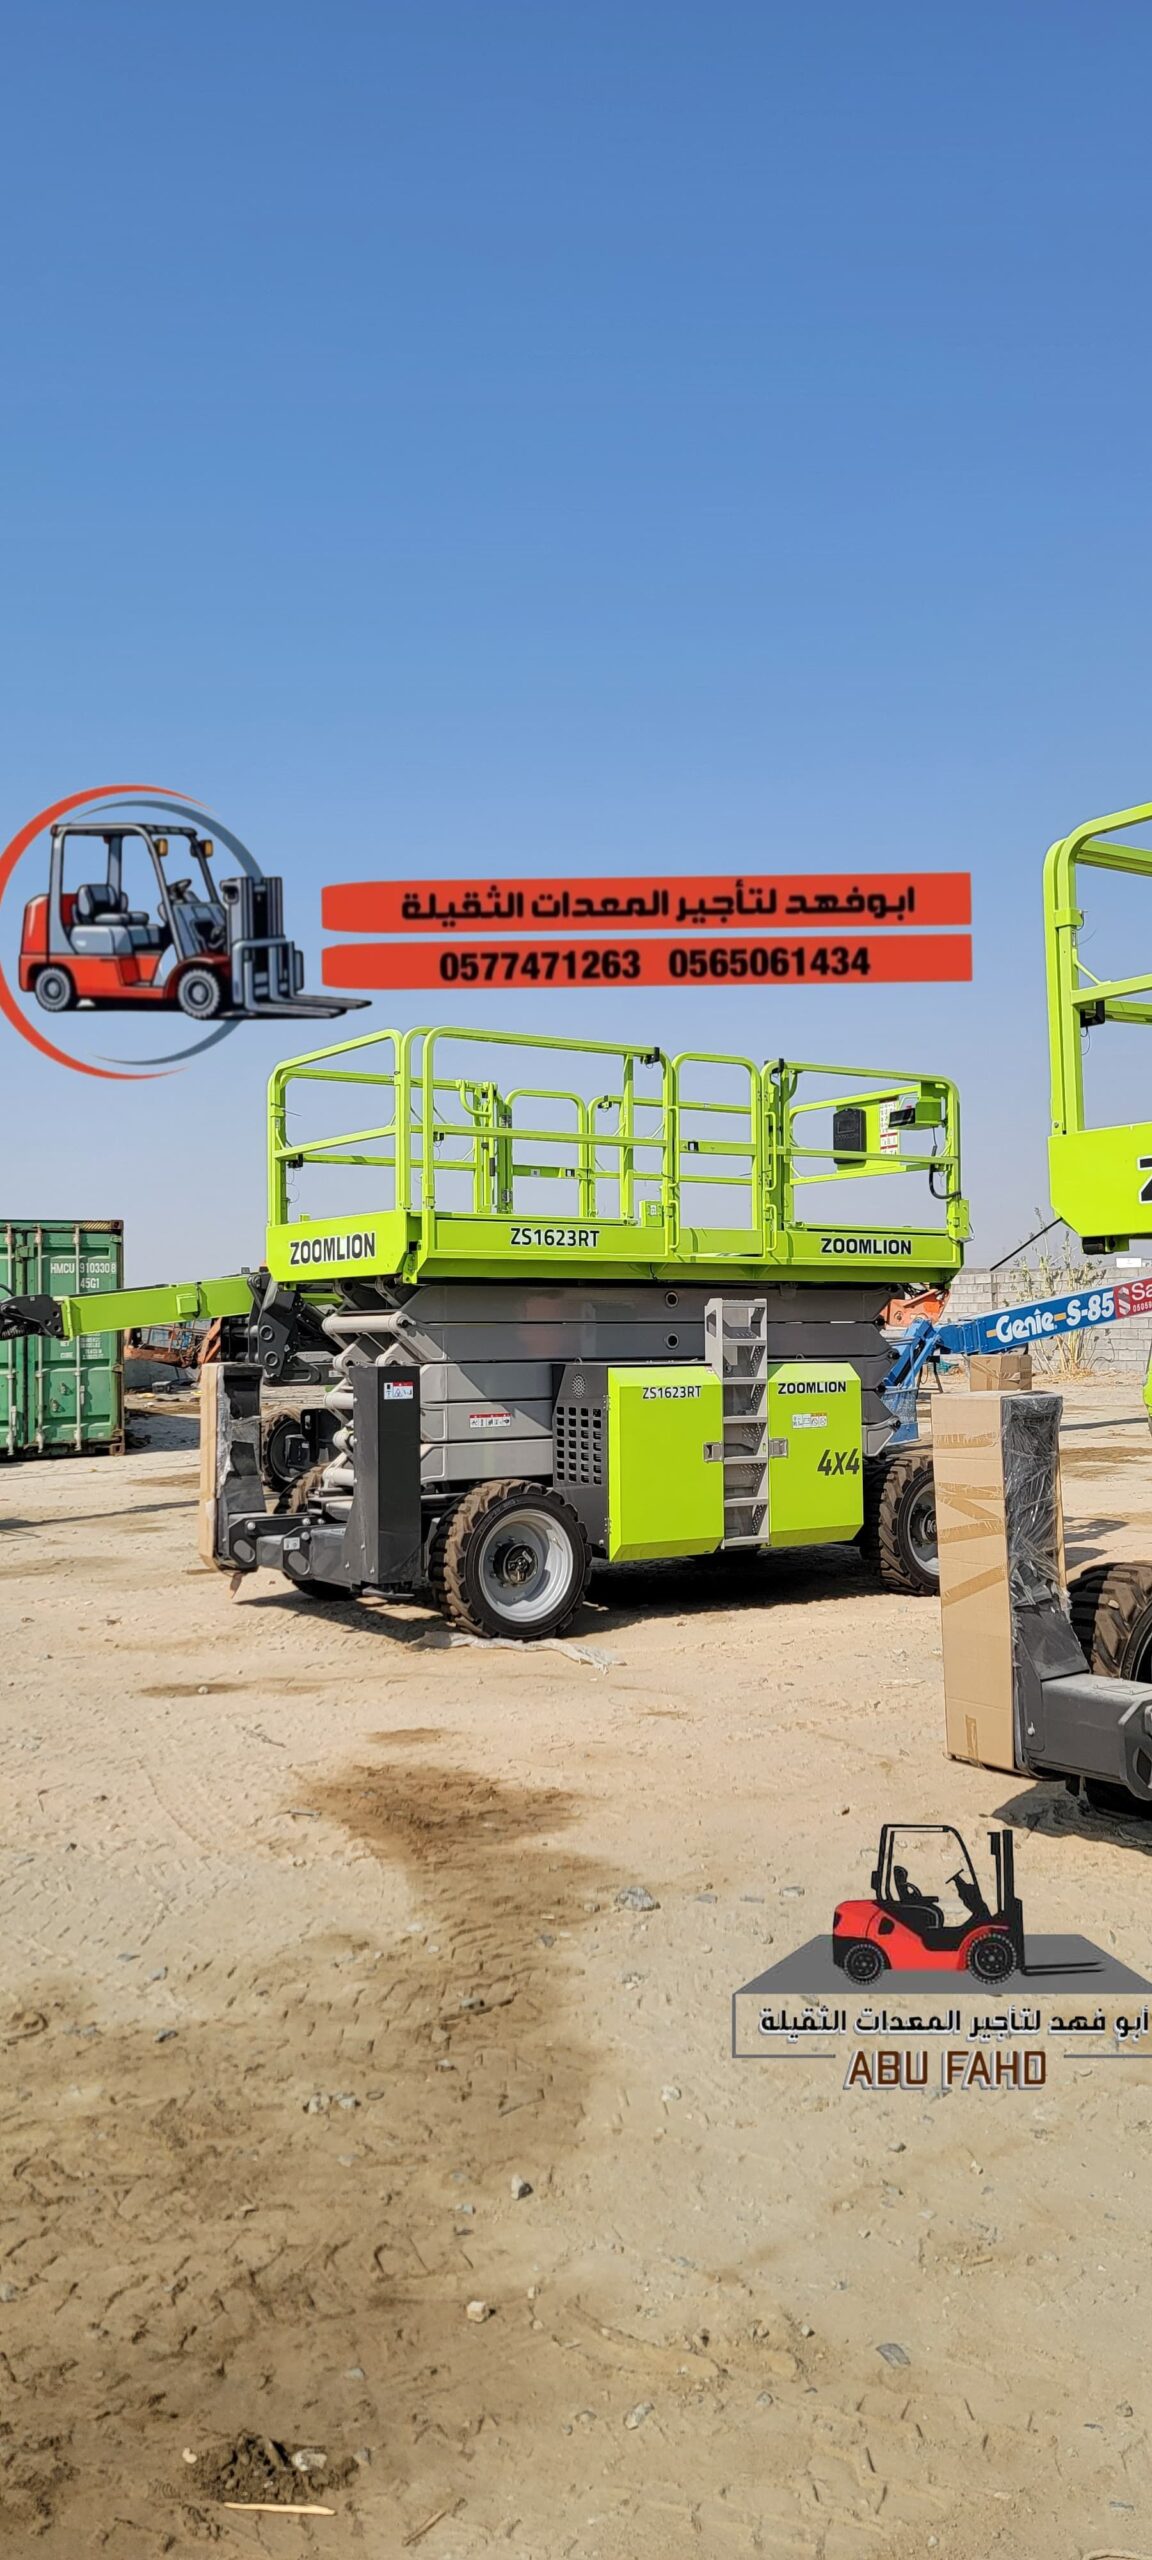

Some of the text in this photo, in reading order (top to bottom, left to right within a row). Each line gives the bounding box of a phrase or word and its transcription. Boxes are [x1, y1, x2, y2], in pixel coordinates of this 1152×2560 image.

[510, 1228, 600, 1247] ZS1623RT
[290, 1233, 375, 1265] ZOOMLION
[821, 1238, 911, 1255] ZOOMLION
[50, 1263, 75, 1274] HMCU
[996, 1291, 1114, 1343] Genie S-85
[642, 1385, 702, 1399] ZS1623RT
[777, 1381, 846, 1395] ZOOMLION
